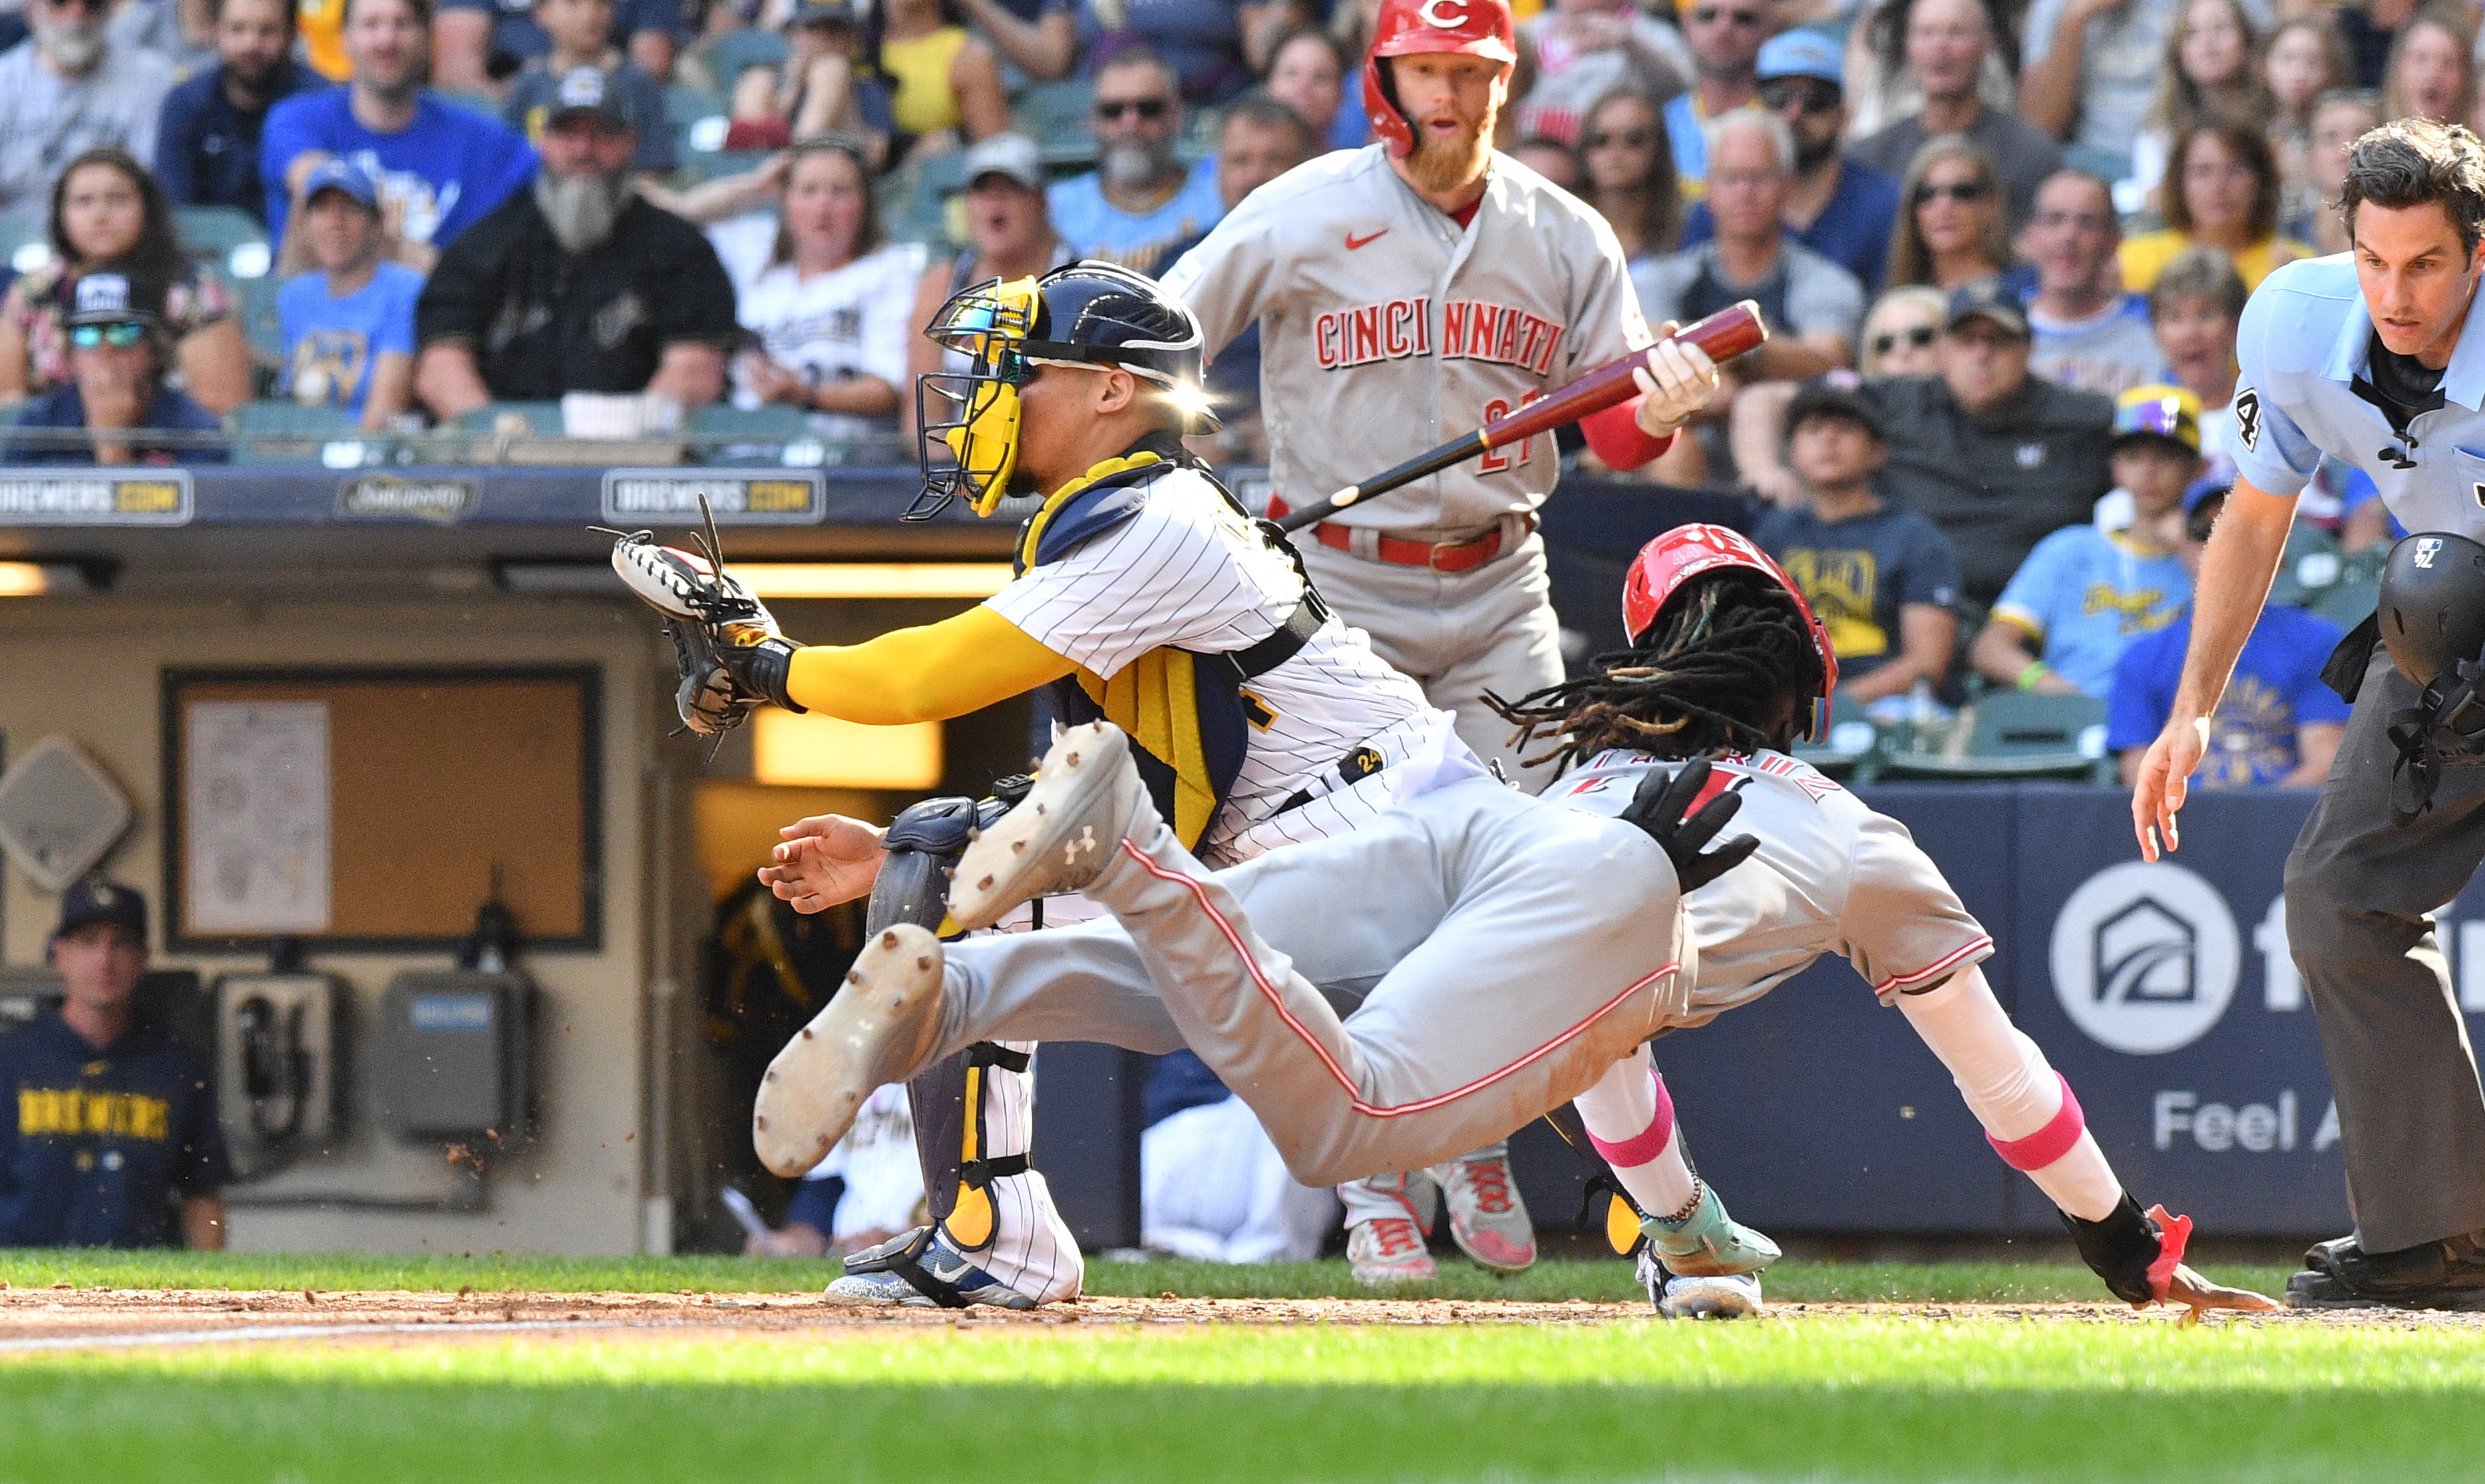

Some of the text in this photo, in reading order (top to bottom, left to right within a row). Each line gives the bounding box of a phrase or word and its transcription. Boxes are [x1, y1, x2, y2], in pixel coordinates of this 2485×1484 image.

[1419, 0, 1469, 29] C
[1672, 544, 1701, 566] 44
[1357, 749, 1382, 773] 24
[2156, 1089, 2296, 1151] Feel
